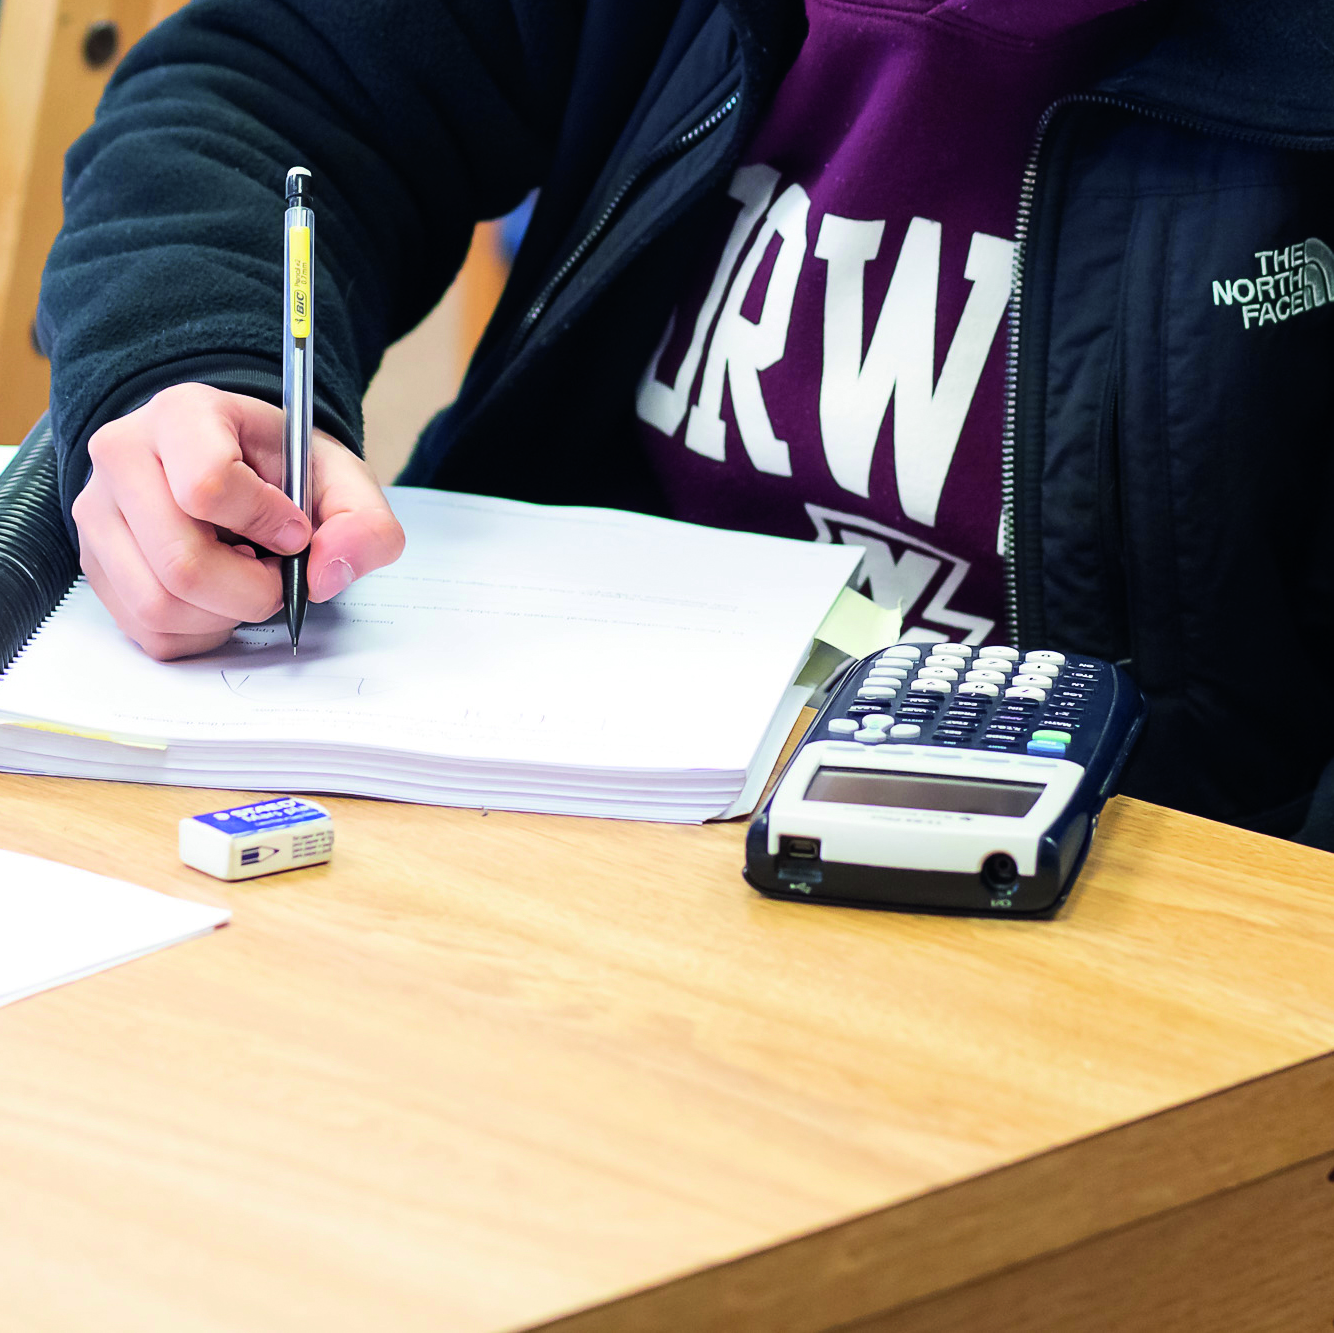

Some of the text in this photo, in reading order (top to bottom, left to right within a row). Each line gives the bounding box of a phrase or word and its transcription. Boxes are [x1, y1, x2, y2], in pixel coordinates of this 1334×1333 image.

[1254, 243, 1304, 275] THE
[1212, 267, 1304, 306] NORTH
[1242, 290, 1304, 329] FACE
